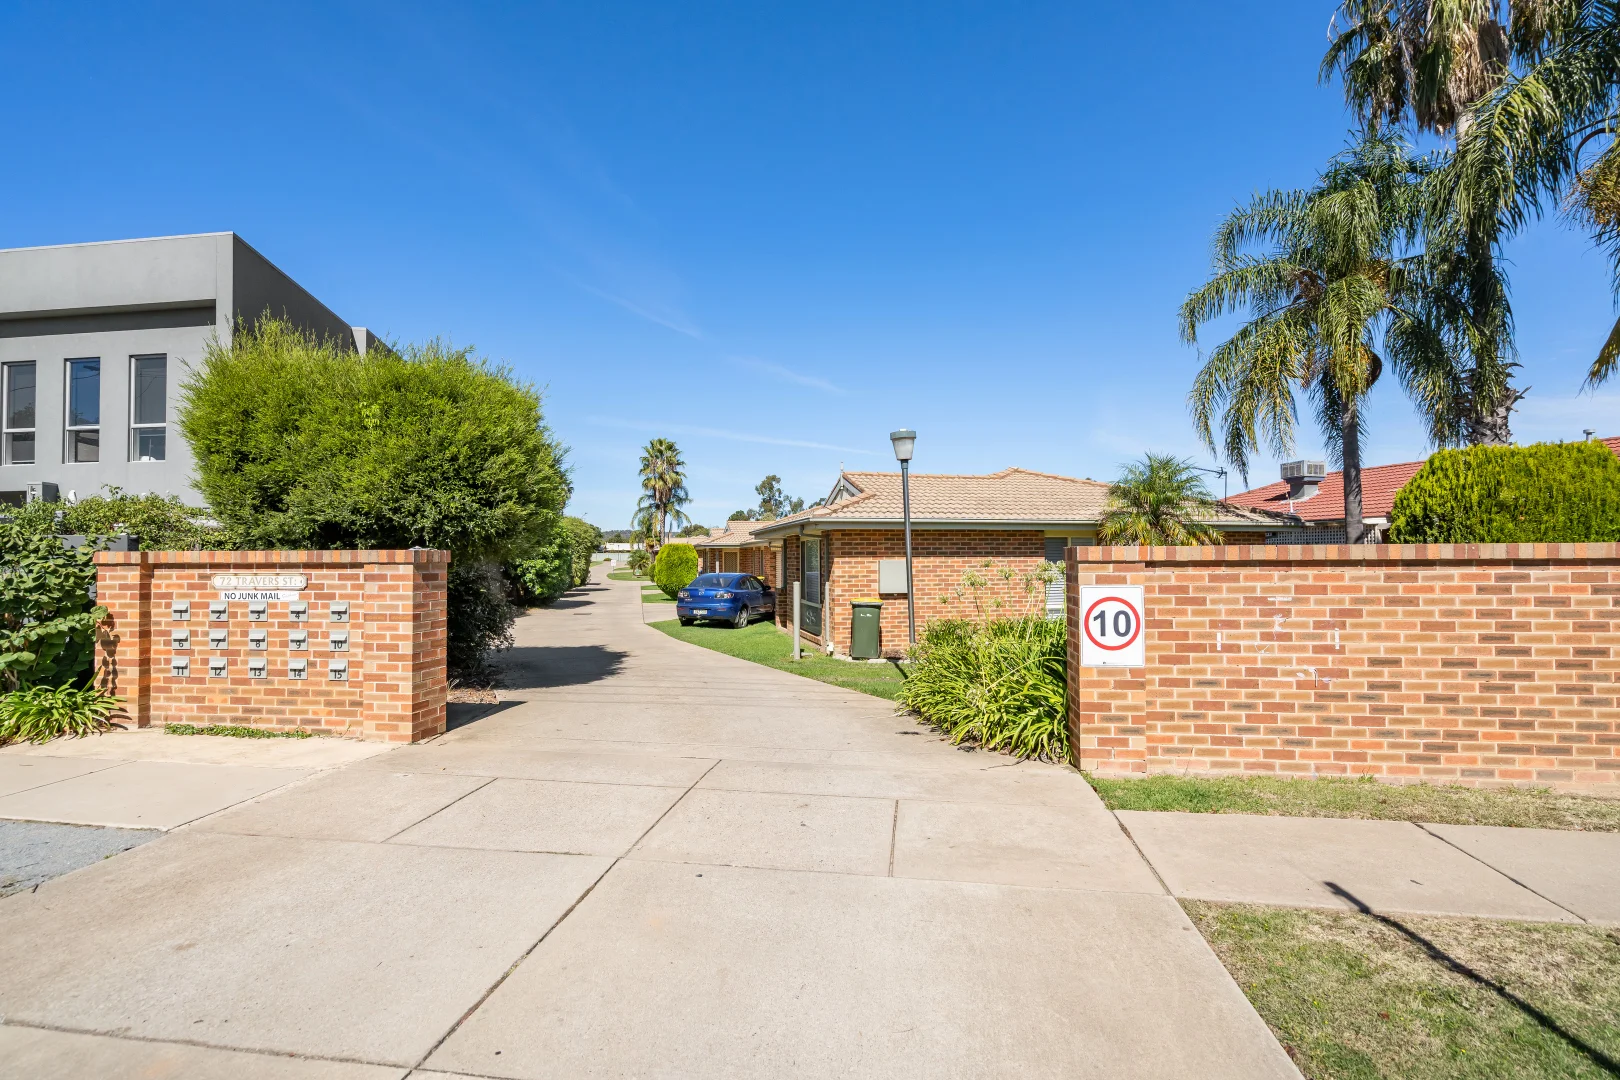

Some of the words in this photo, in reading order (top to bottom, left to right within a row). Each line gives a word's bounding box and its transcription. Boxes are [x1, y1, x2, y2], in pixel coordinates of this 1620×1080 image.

[220, 577, 232, 585] 72
[235, 577, 279, 585] TRAVERS
[1093, 610, 1131, 637] 10
[334, 641, 342, 649] 10
[293, 670, 301, 678] 14
[334, 671, 342, 679] 15
